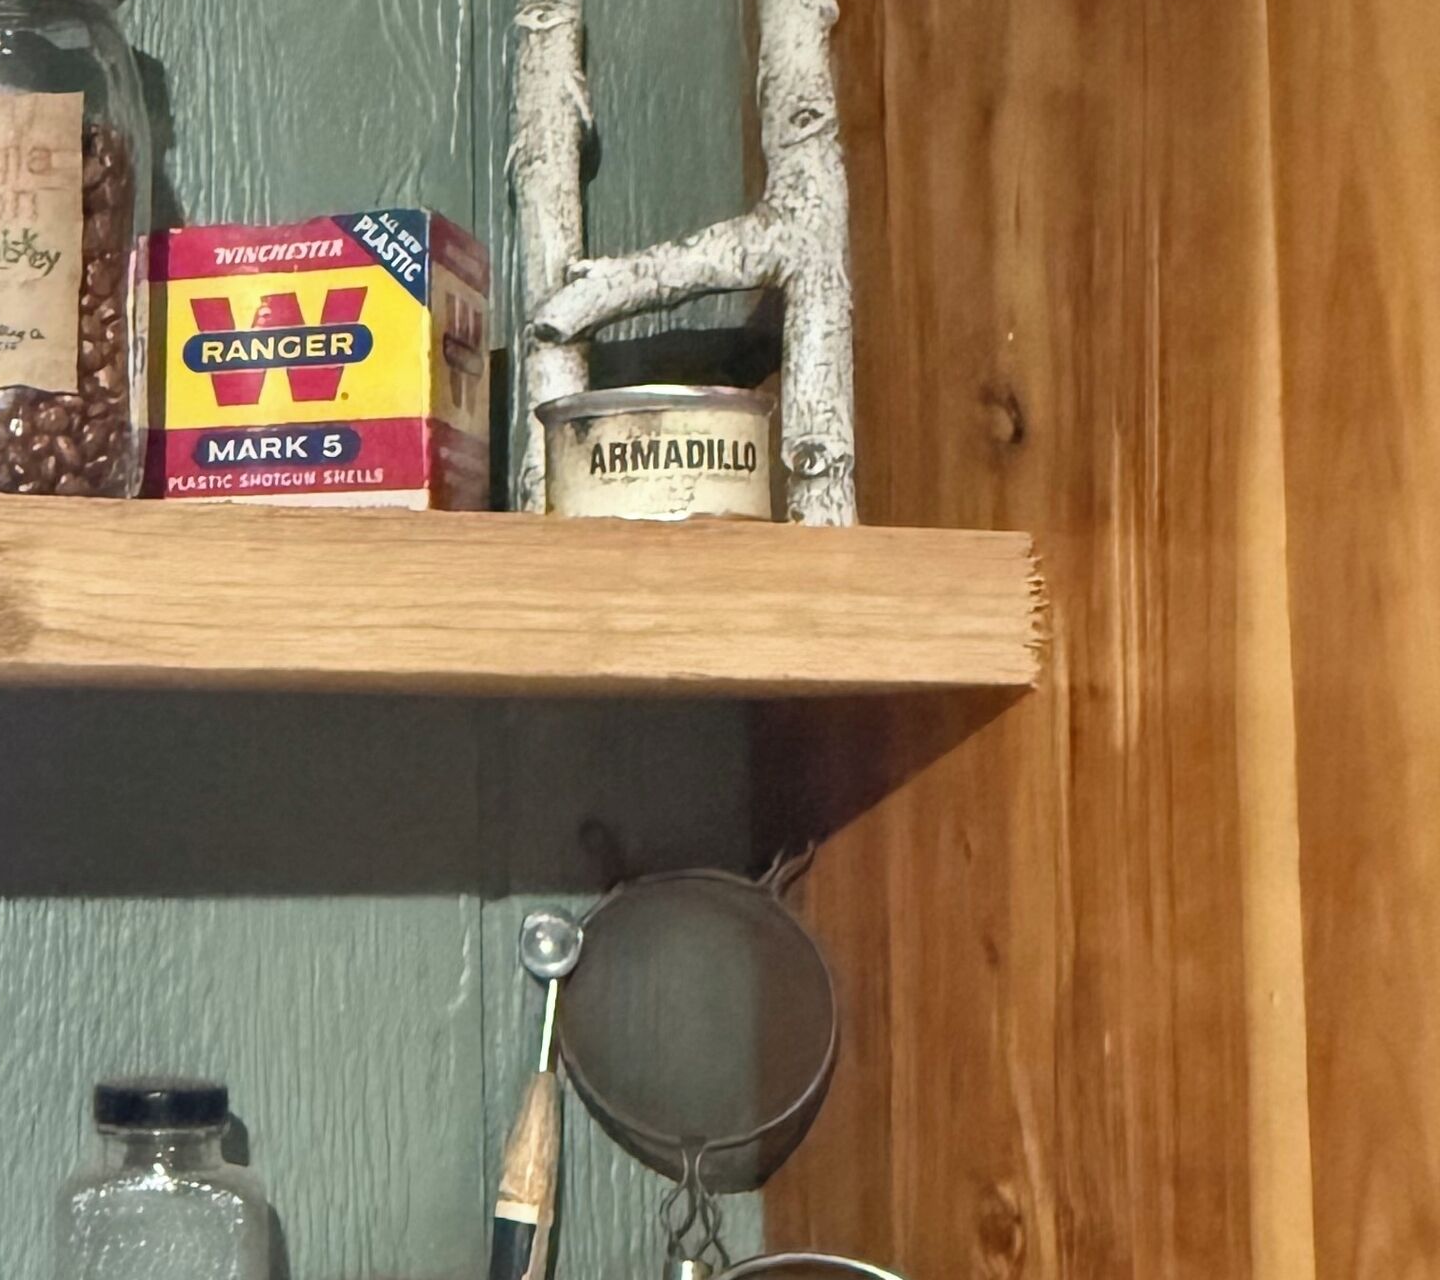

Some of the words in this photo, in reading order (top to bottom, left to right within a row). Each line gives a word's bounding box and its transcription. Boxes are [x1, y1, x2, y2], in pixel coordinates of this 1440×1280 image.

[214, 238, 344, 266] WINCHESTER
[353, 215, 422, 282] PLASTIC
[201, 332, 354, 365] RANGER
[208, 434, 309, 463] MARK
[322, 433, 343, 458] 5
[589, 438, 757, 475] ARMADILLO
[168, 473, 232, 492] PLASTIC
[240, 471, 316, 489] SHOTGUN
[323, 468, 384, 485] SHELLS
